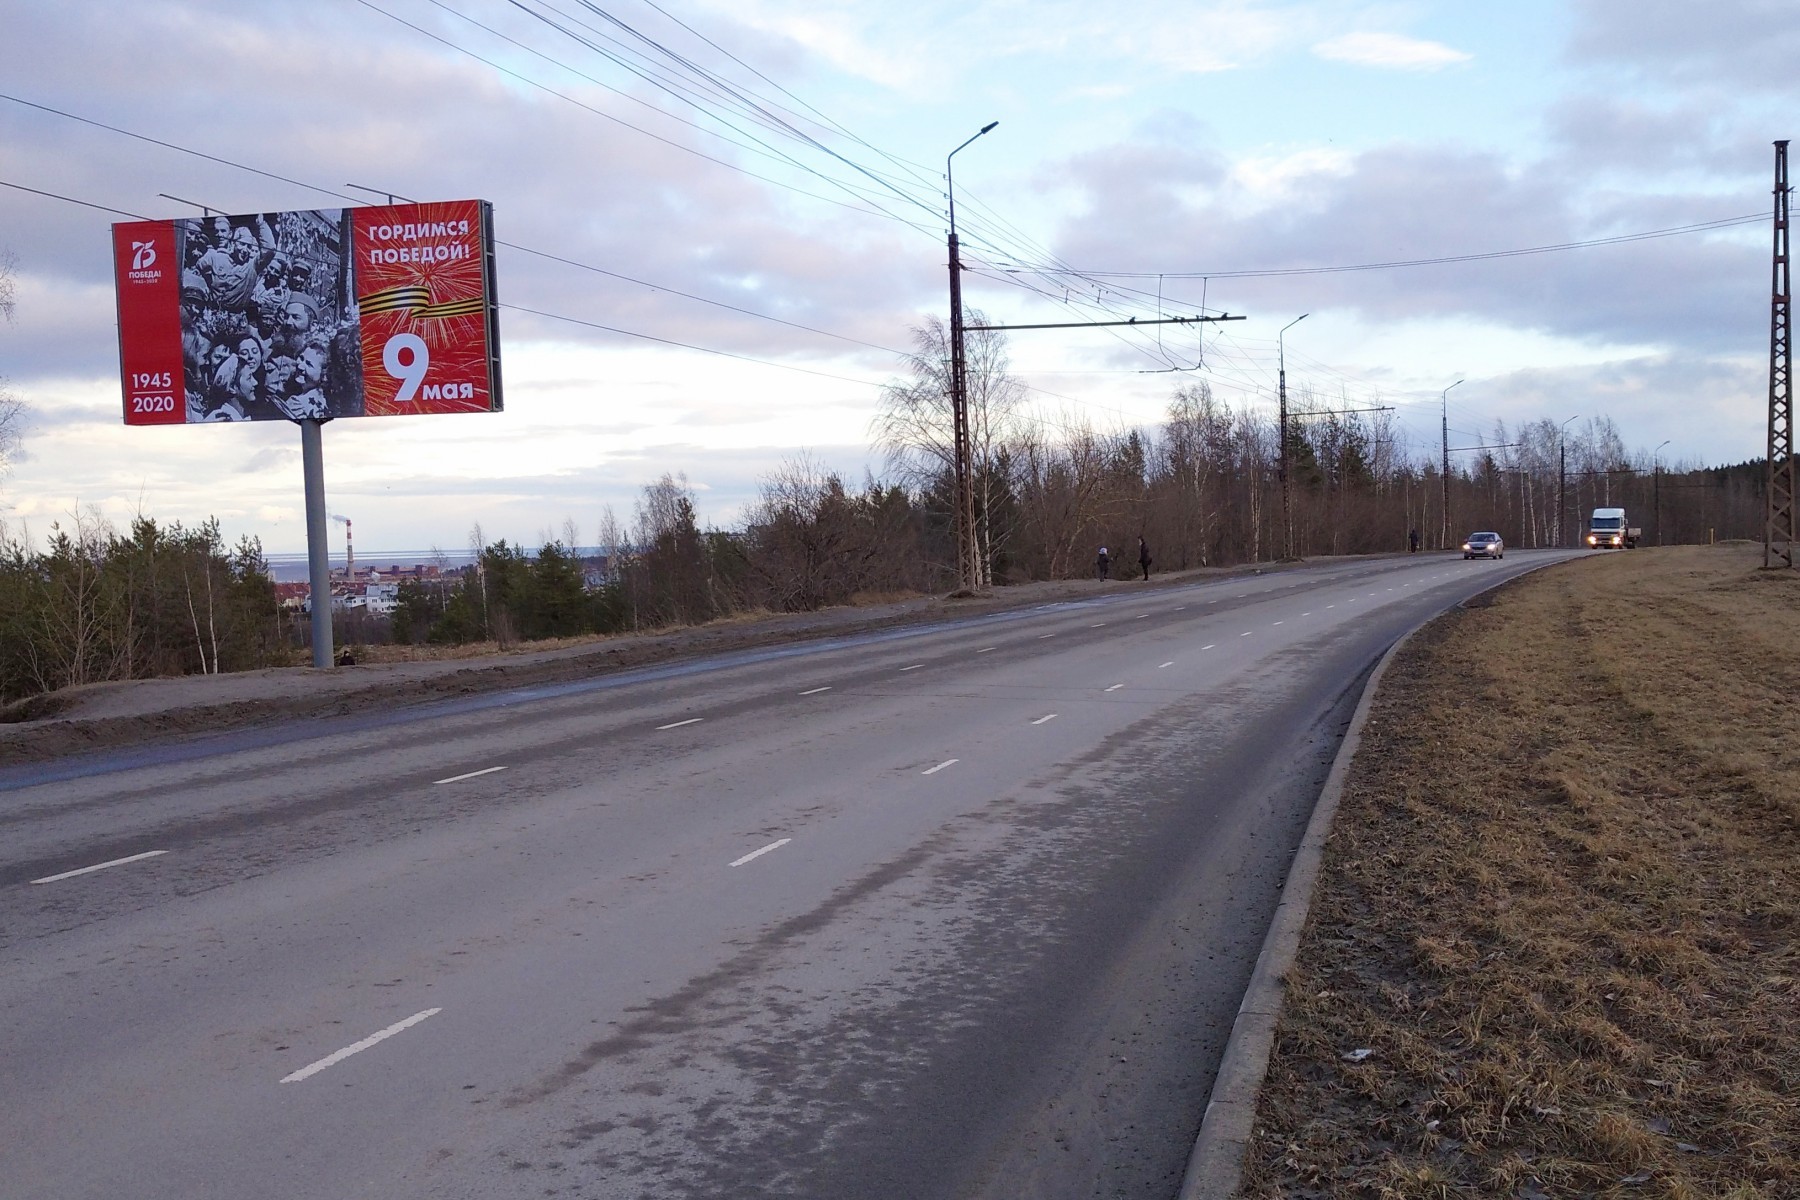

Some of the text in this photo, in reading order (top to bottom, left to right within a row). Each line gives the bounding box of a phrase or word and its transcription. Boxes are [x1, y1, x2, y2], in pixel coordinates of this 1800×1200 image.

[368, 220, 470, 241] ГОРДИМСЯ
[132, 239, 157, 270] 75
[370, 241, 471, 264] ПОБЕДОЙ!
[128, 270, 162, 279] ПОБЕДА!
[382, 332, 474, 402] 9 мая
[132, 373, 172, 389] 1945
[133, 395, 175, 414] 2020
